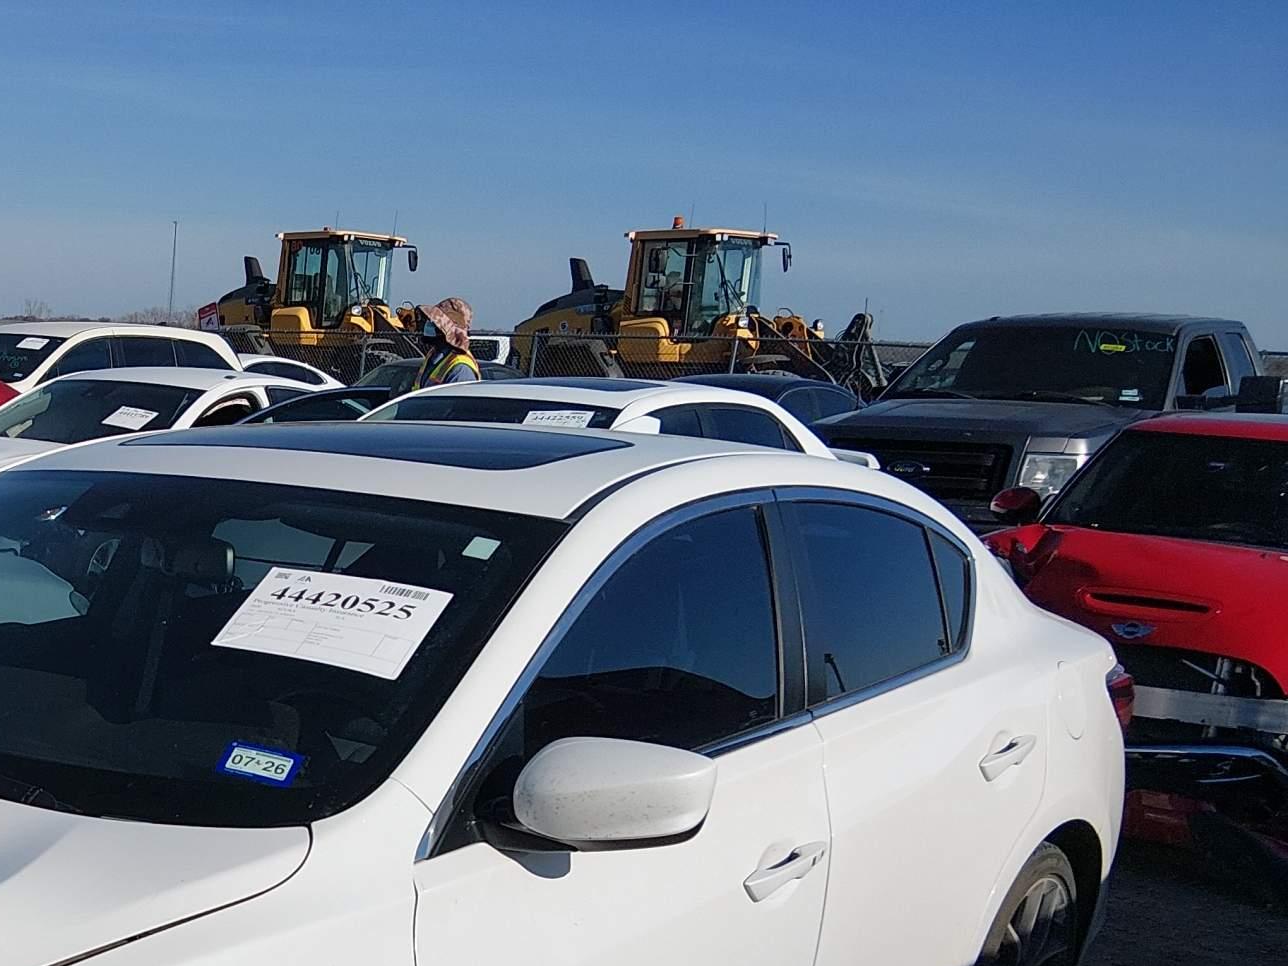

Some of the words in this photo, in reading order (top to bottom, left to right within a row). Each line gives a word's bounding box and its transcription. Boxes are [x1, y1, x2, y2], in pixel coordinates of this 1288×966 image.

[359, 239, 382, 248] VOLVO
[270, 586, 417, 621] 44420525
[230, 753, 256, 767] 07
[262, 760, 287, 775] 26
